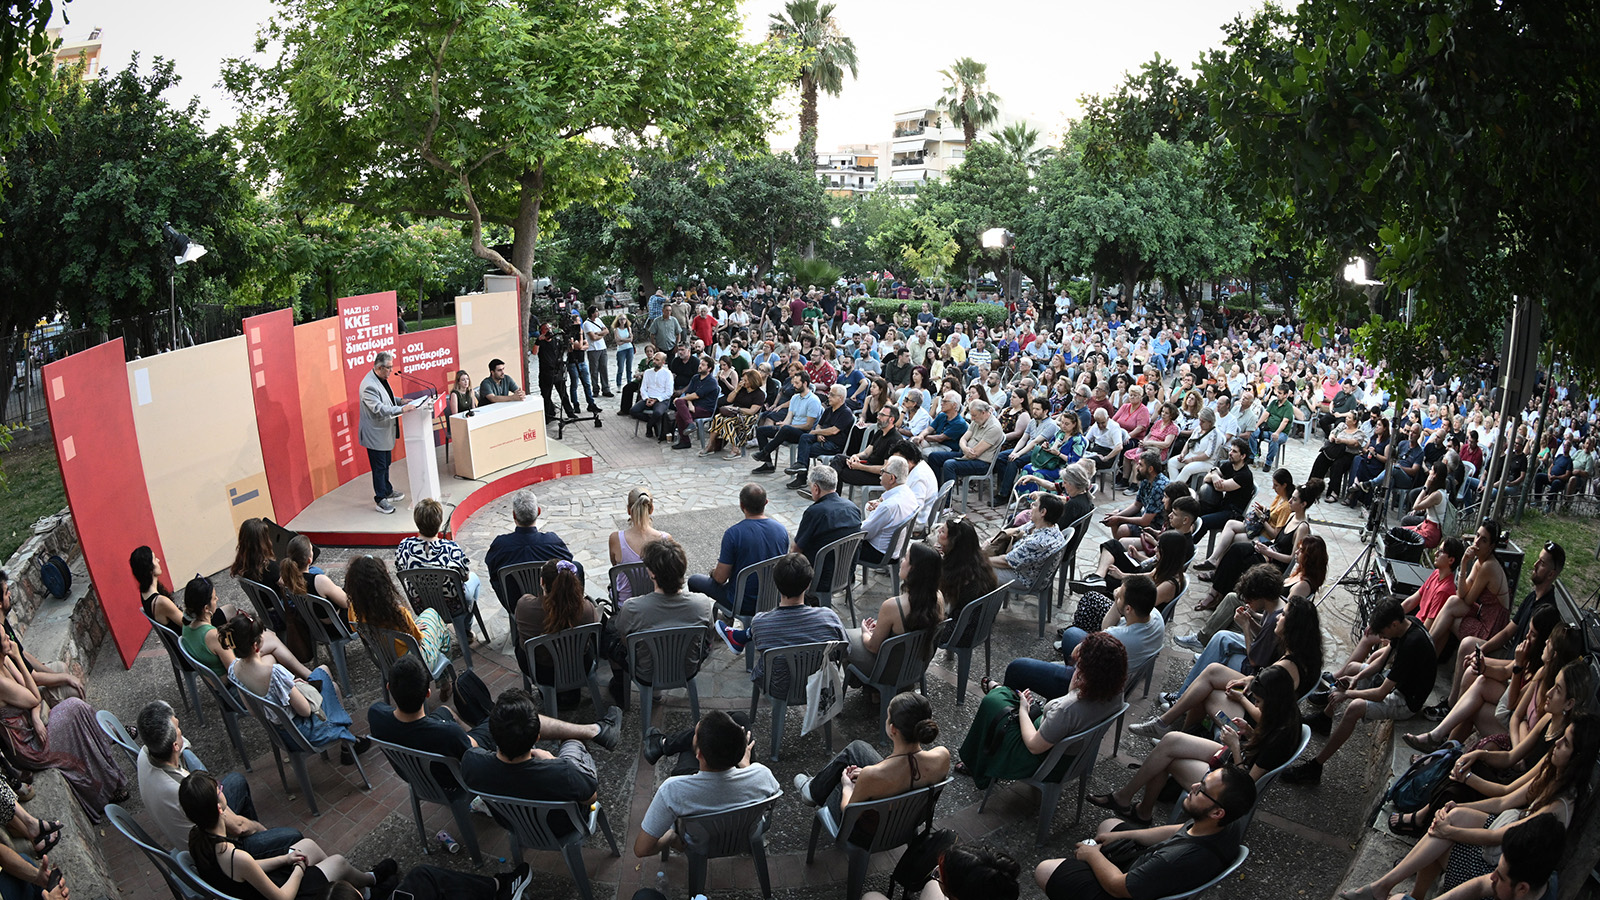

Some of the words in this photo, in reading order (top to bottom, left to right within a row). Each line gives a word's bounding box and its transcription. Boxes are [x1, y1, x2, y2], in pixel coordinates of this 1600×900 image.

[344, 306, 362, 316] ΜΑΖΙ
[344, 314, 370, 330] ΚΚΕ
[356, 322, 394, 340] ΣΤΕΓΗ
[346, 336, 394, 354] δικαίωμα
[407, 342, 424, 353] ΟΧΙ
[346, 356, 364, 370] για
[402, 348, 450, 364] πανάκριβο
[404, 357, 453, 374] εμπόρευμα
[523, 431, 536, 440] ΚΚΕ
